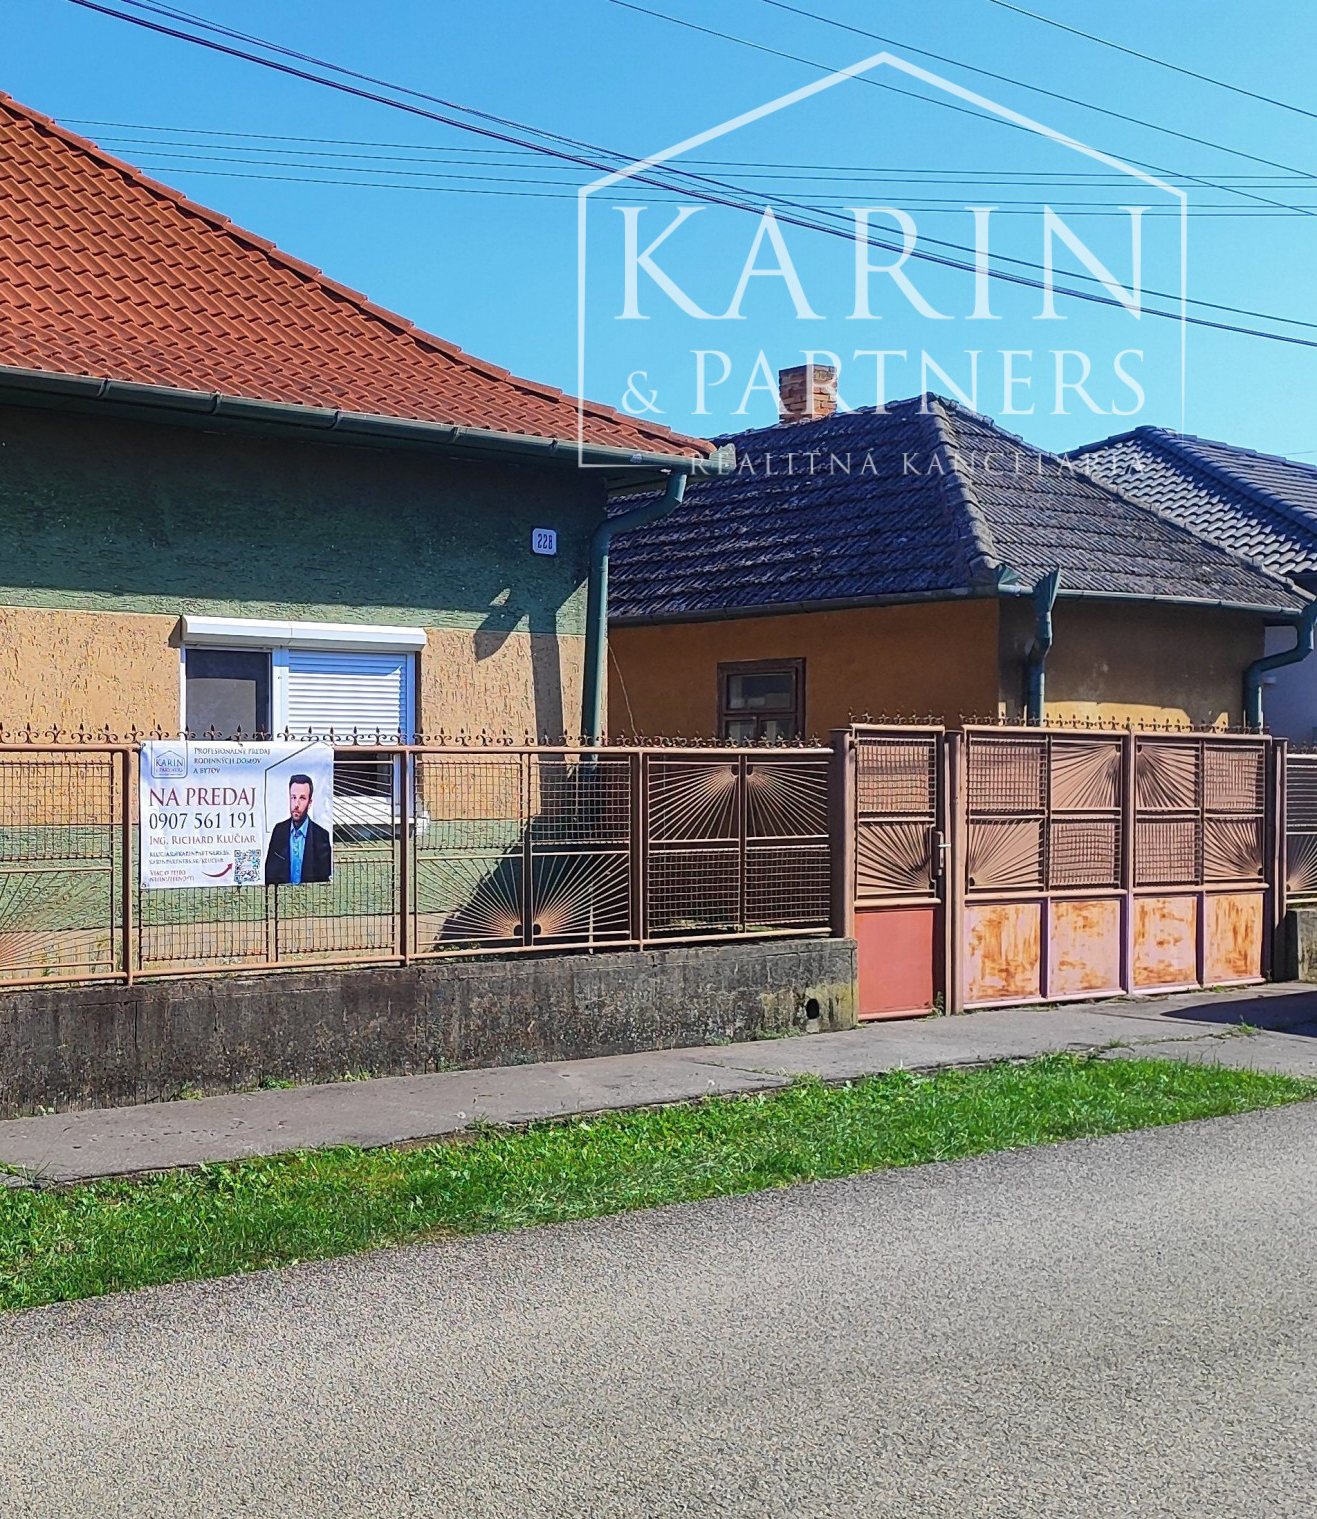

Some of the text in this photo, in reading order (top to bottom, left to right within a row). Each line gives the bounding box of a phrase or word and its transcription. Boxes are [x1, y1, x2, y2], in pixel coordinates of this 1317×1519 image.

[537, 533, 553, 550] 228
[156, 758, 184, 767] KARIN
[149, 787, 257, 811] NA PREDAJ
[149, 811, 256, 830] 0907 561 191
[149, 832, 257, 846] ING. RICHARD KLUČIAR
